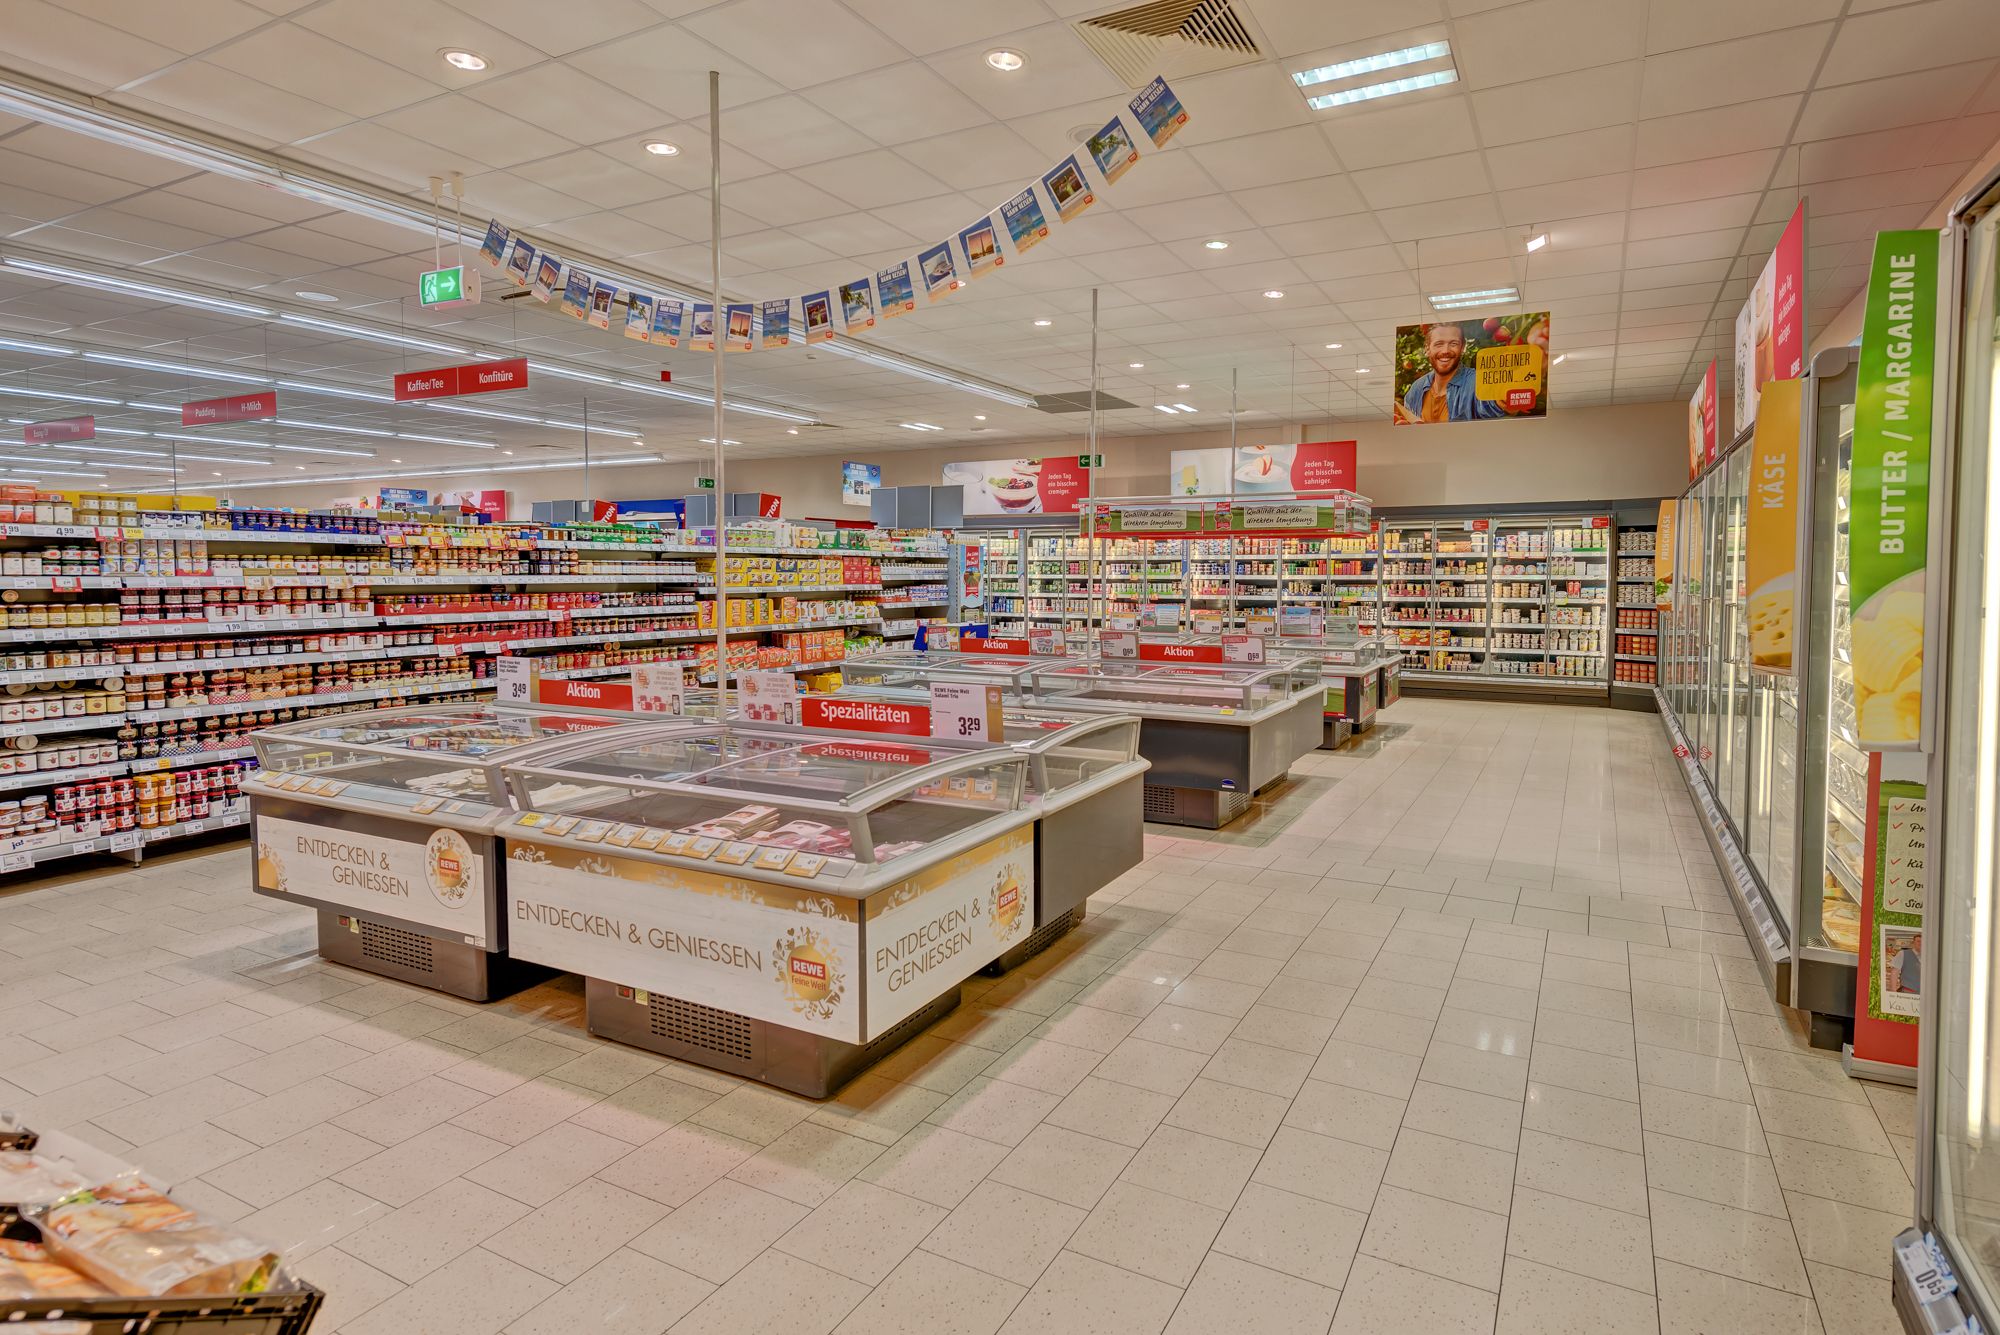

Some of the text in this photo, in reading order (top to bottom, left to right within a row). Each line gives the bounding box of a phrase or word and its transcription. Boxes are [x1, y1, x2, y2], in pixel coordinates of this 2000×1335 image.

[1480, 352, 1530, 369] AUS DEINER
[407, 370, 514, 392] Kaffee/Tee Konfitüre
[1483, 370, 1514, 385] REGION
[1511, 392, 1531, 400] REWE
[1880, 253, 1916, 554] BUTTER / MARGARINE
[195, 401, 262, 418] Pudding H-Milch
[1315, 468, 1343, 476] bisschen
[1324, 461, 1335, 469] Tag
[1304, 477, 1332, 485] sahniger.
[1758, 452, 1786, 509] KÄSE
[1246, 507, 1275, 515] Qualität
[1661, 513, 1671, 561] FRISCHKÄSE
[982, 639, 1009, 650] Aktion
[1163, 646, 1195, 657] Aktion
[566, 682, 601, 699] Aktion
[820, 701, 911, 724] Spezialitäten
[297, 836, 390, 871] ENTDECKEN &
[440, 859, 459, 871] REWE
[332, 866, 409, 898] GENIESSEN
[1000, 889, 1017, 908] REWE
[516, 900, 762, 973] ENTDECKEN & GENIESSEN
[876, 897, 981, 973] ENTDECKEN &
[888, 926, 973, 992] GENIESSEN
[793, 960, 824, 977] REWE
[791, 975, 826, 991] Feine Welt
